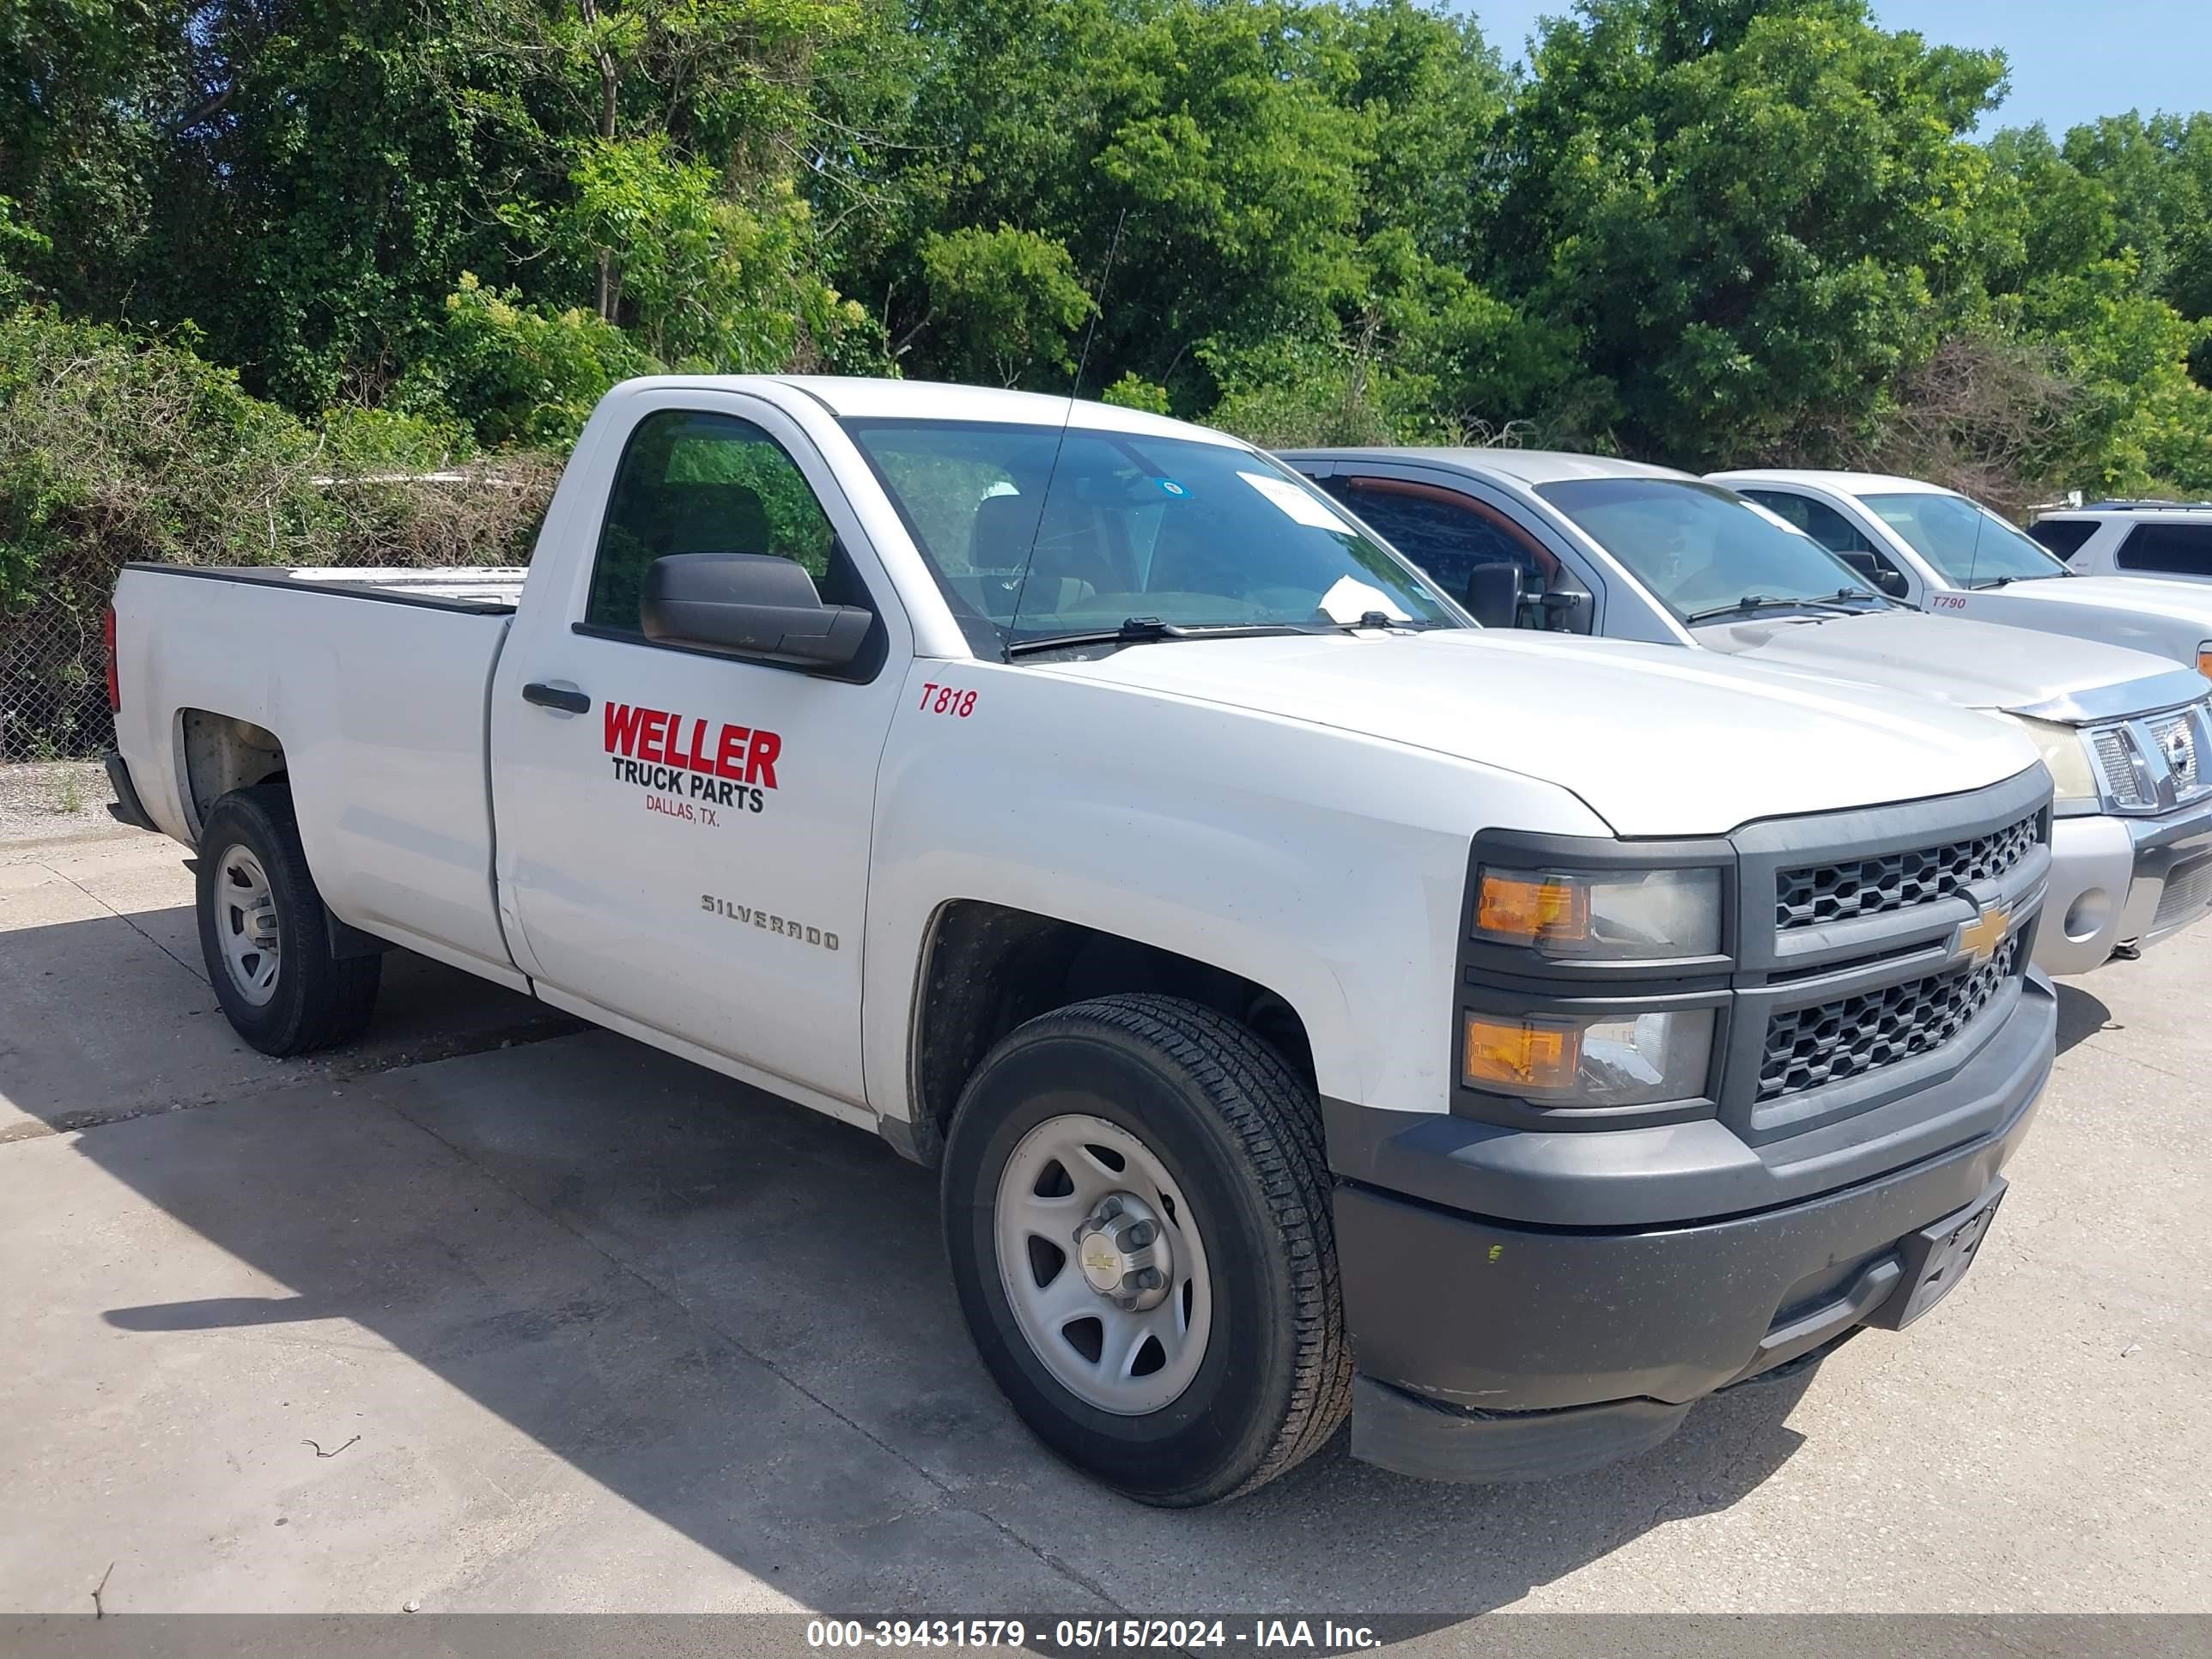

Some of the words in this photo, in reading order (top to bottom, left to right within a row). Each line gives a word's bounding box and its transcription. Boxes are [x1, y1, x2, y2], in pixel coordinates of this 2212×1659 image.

[1933, 596, 1966, 609] T790
[920, 683, 977, 718] T818
[605, 701, 782, 790] WELLER
[612, 757, 684, 795] TRUCK
[690, 775, 763, 814] PARTS
[646, 794, 697, 825] DALLAS,
[700, 807, 720, 828] TX.
[701, 894, 839, 951] SILVERADO
